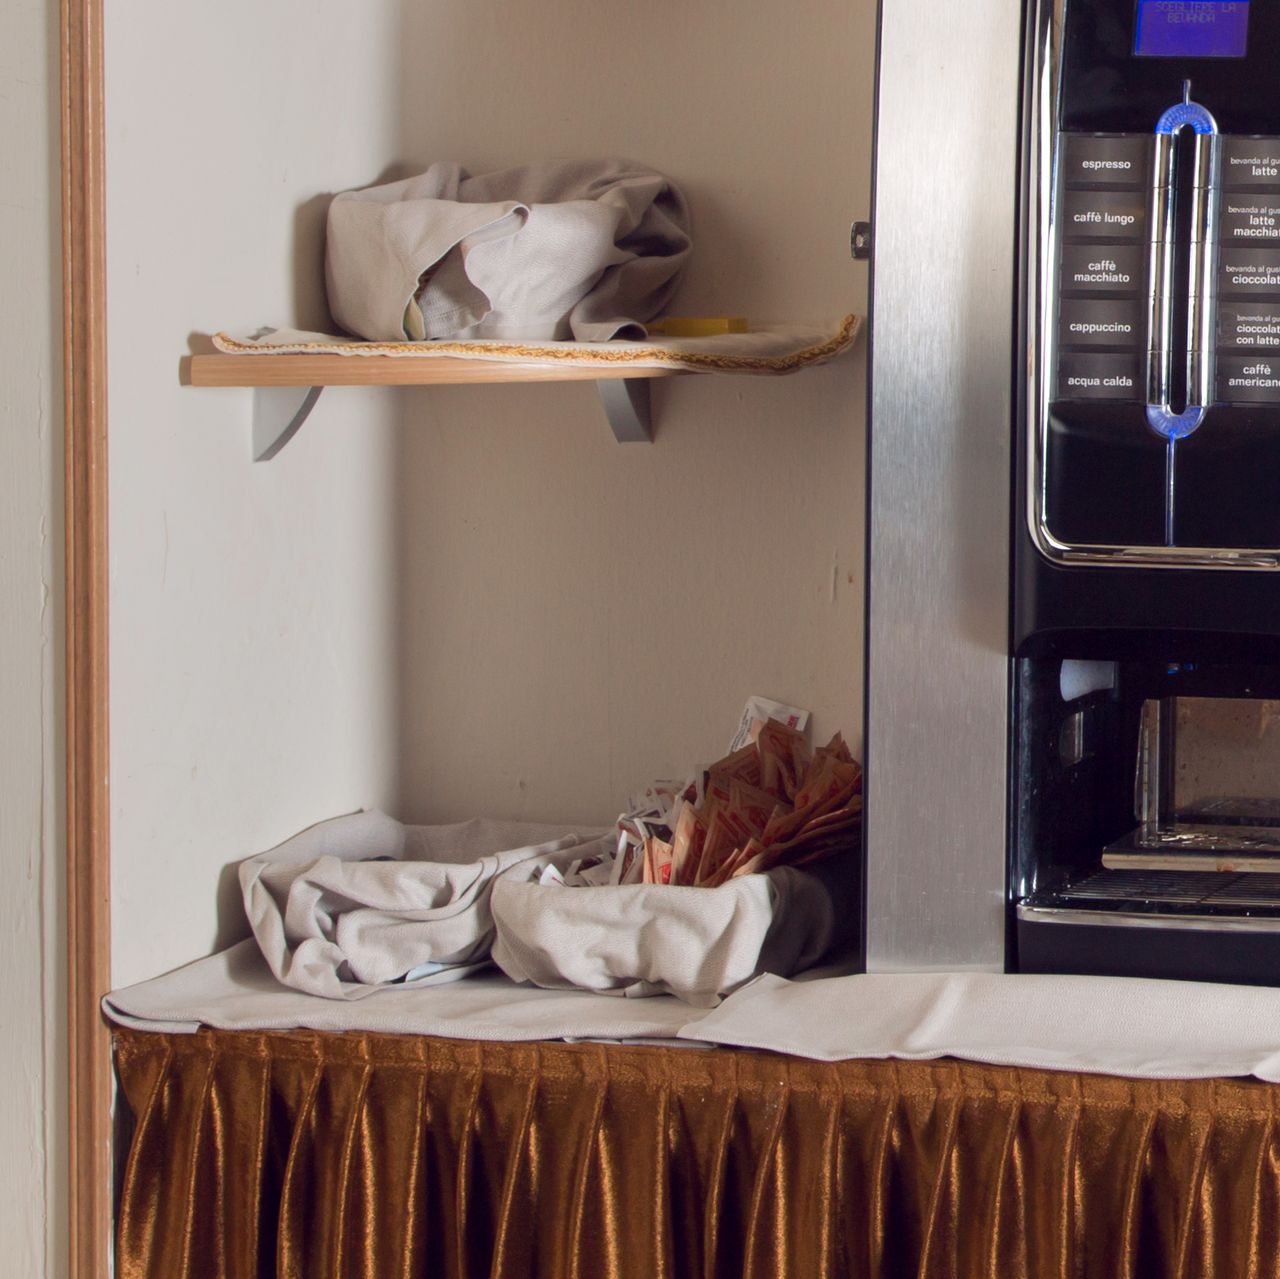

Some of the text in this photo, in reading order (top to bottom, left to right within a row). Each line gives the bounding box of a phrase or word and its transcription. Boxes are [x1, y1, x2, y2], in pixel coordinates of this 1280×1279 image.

[1082, 160, 1131, 170] espresso
[1230, 157, 1261, 165] bevanda
[1262, 157, 1269, 165] al
[1252, 166, 1278, 177] latte
[1228, 206, 1259, 214] bevanda
[1260, 206, 1267, 214] al
[1073, 213, 1135, 225] caffè lungo
[1249, 215, 1275, 226] latte
[1088, 260, 1116, 271] caffè
[1225, 265, 1256, 273] bevanda
[1074, 272, 1130, 283] macchiato
[1069, 322, 1131, 335] cappuccino
[1236, 335, 1280, 345] con latte
[1243, 364, 1272, 375] caffè
[1067, 376, 1133, 387] acqua calda
